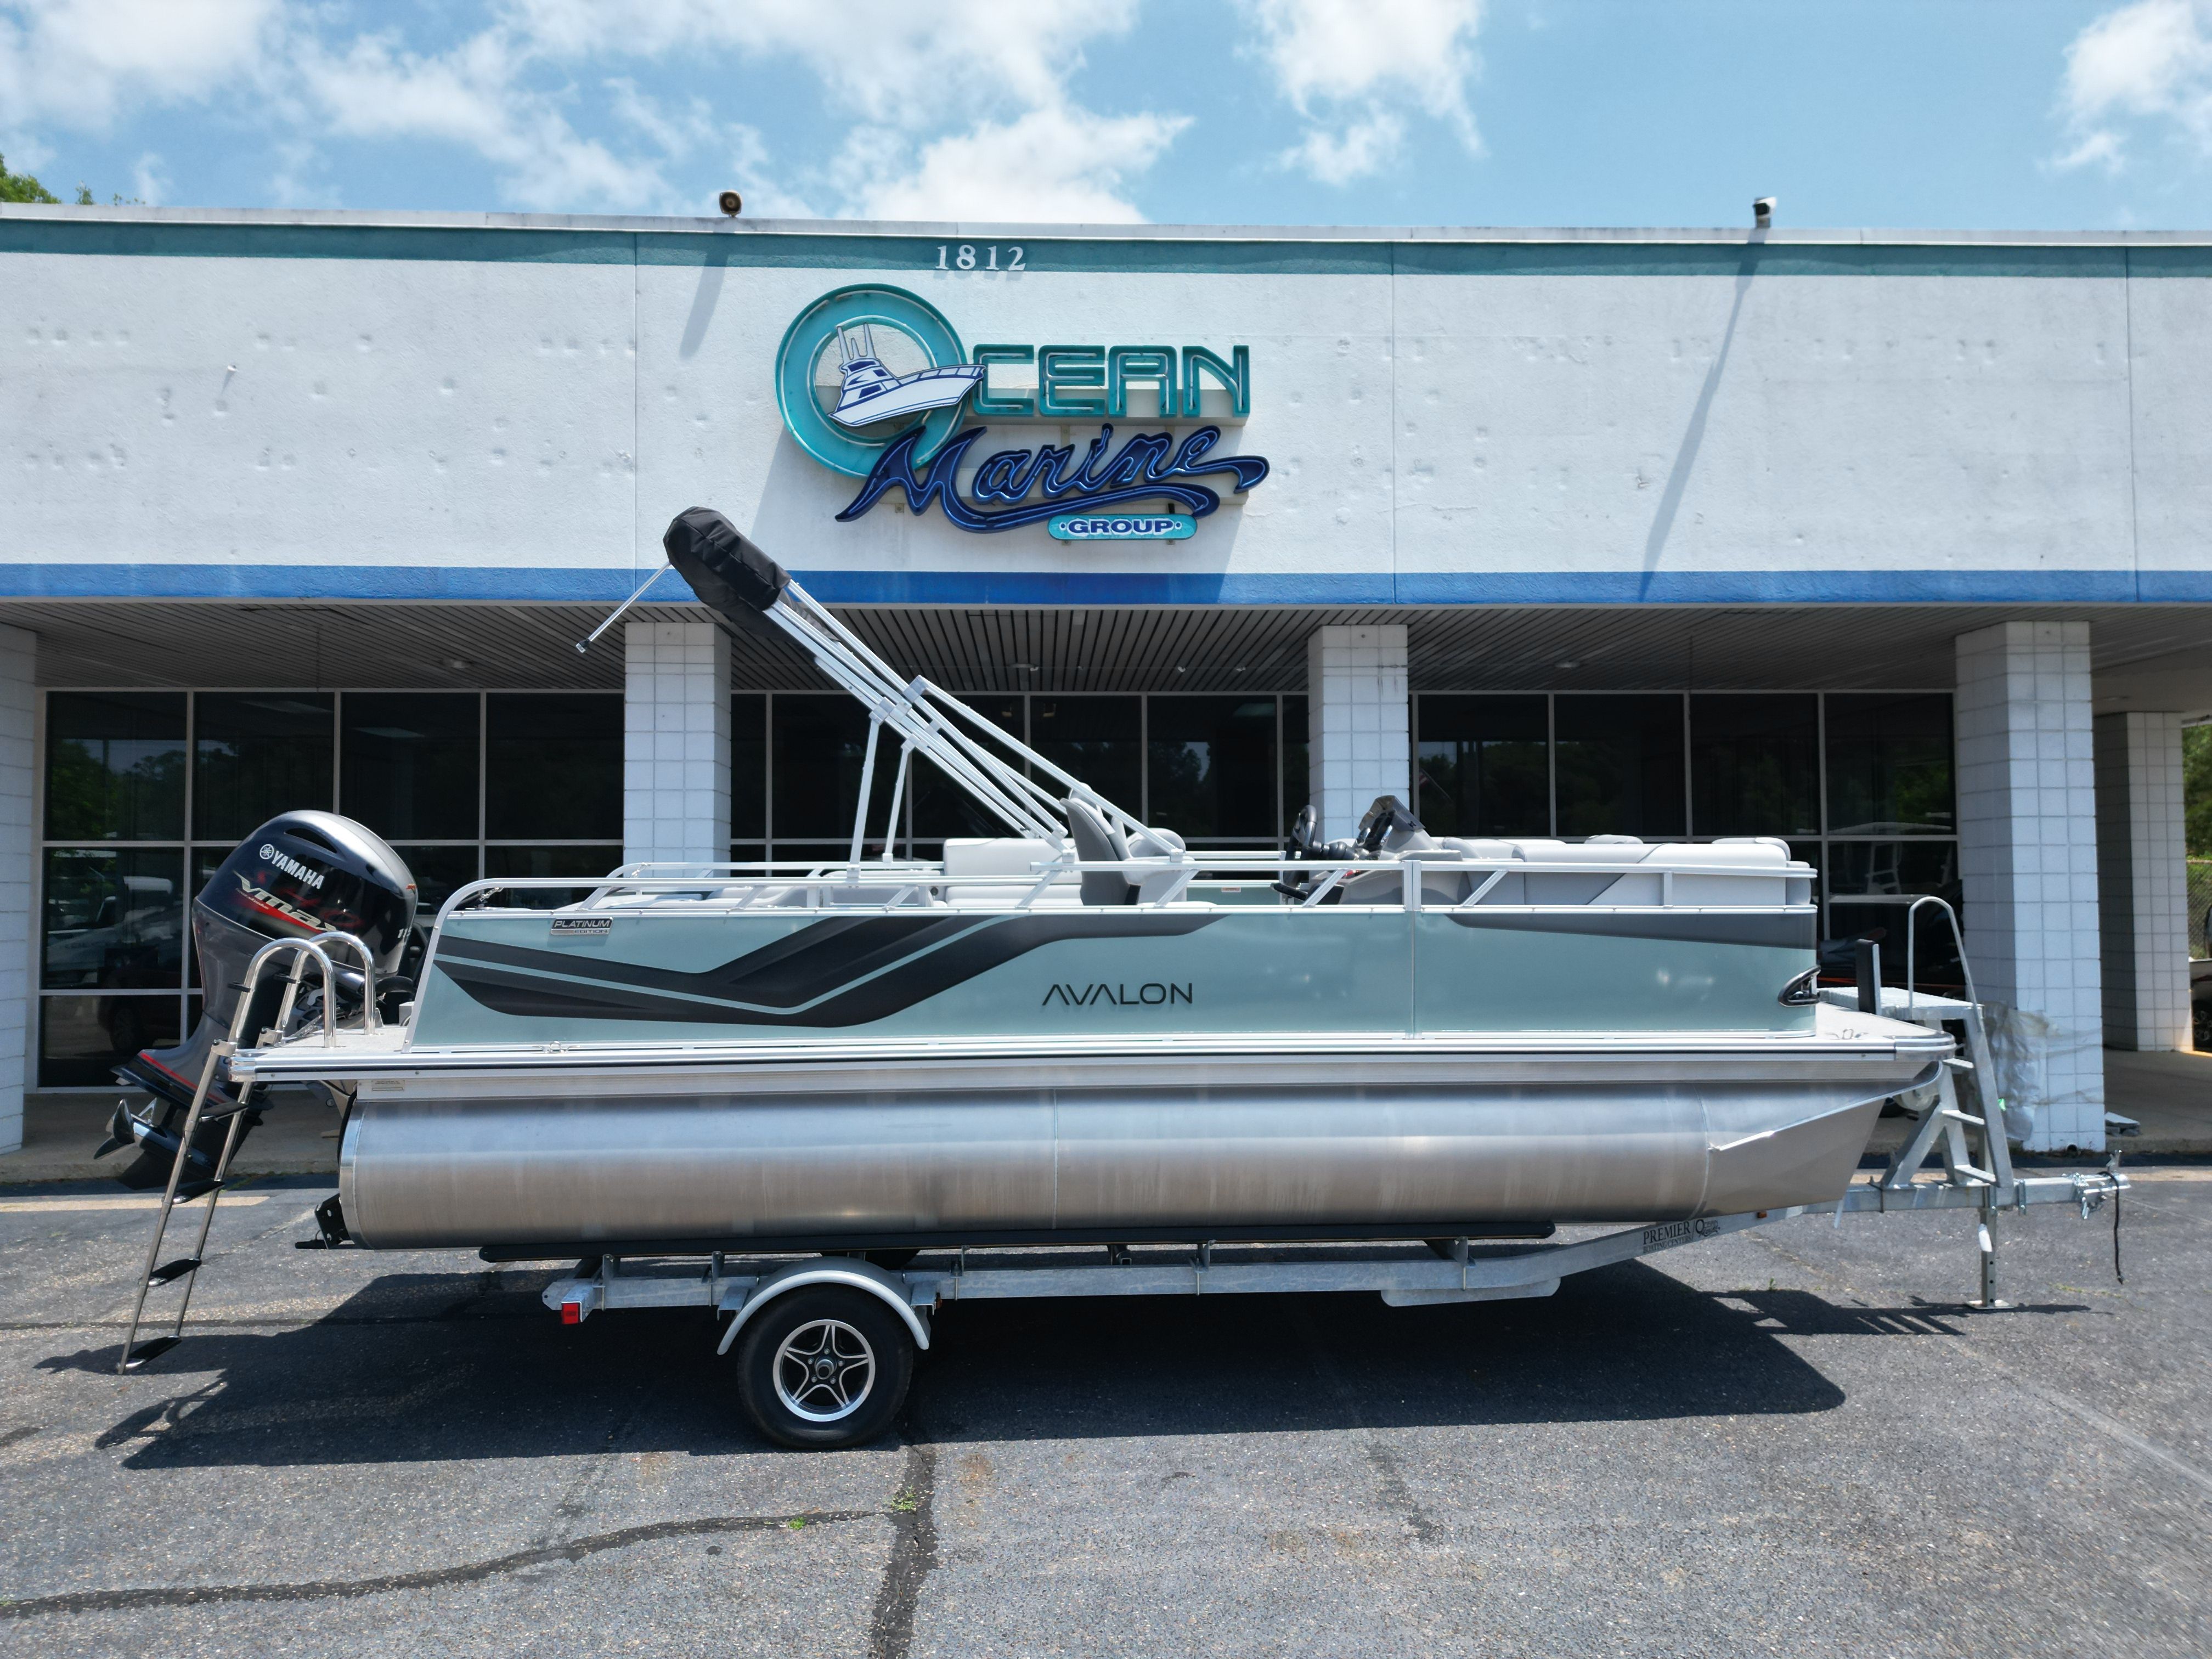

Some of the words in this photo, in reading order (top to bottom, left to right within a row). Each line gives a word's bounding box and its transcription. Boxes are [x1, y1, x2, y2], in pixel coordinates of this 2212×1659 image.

[935, 244, 1026, 270] 1812
[775, 283, 1250, 478] OCEAN
[835, 423, 1270, 534] Marine
[1068, 518, 1174, 535] GROUP
[272, 850, 325, 890] YAMAHA
[1042, 983, 1193, 1006] AVALON
[1643, 1221, 1691, 1245] PREMIER
[1643, 1242, 1667, 1254] BOATING
